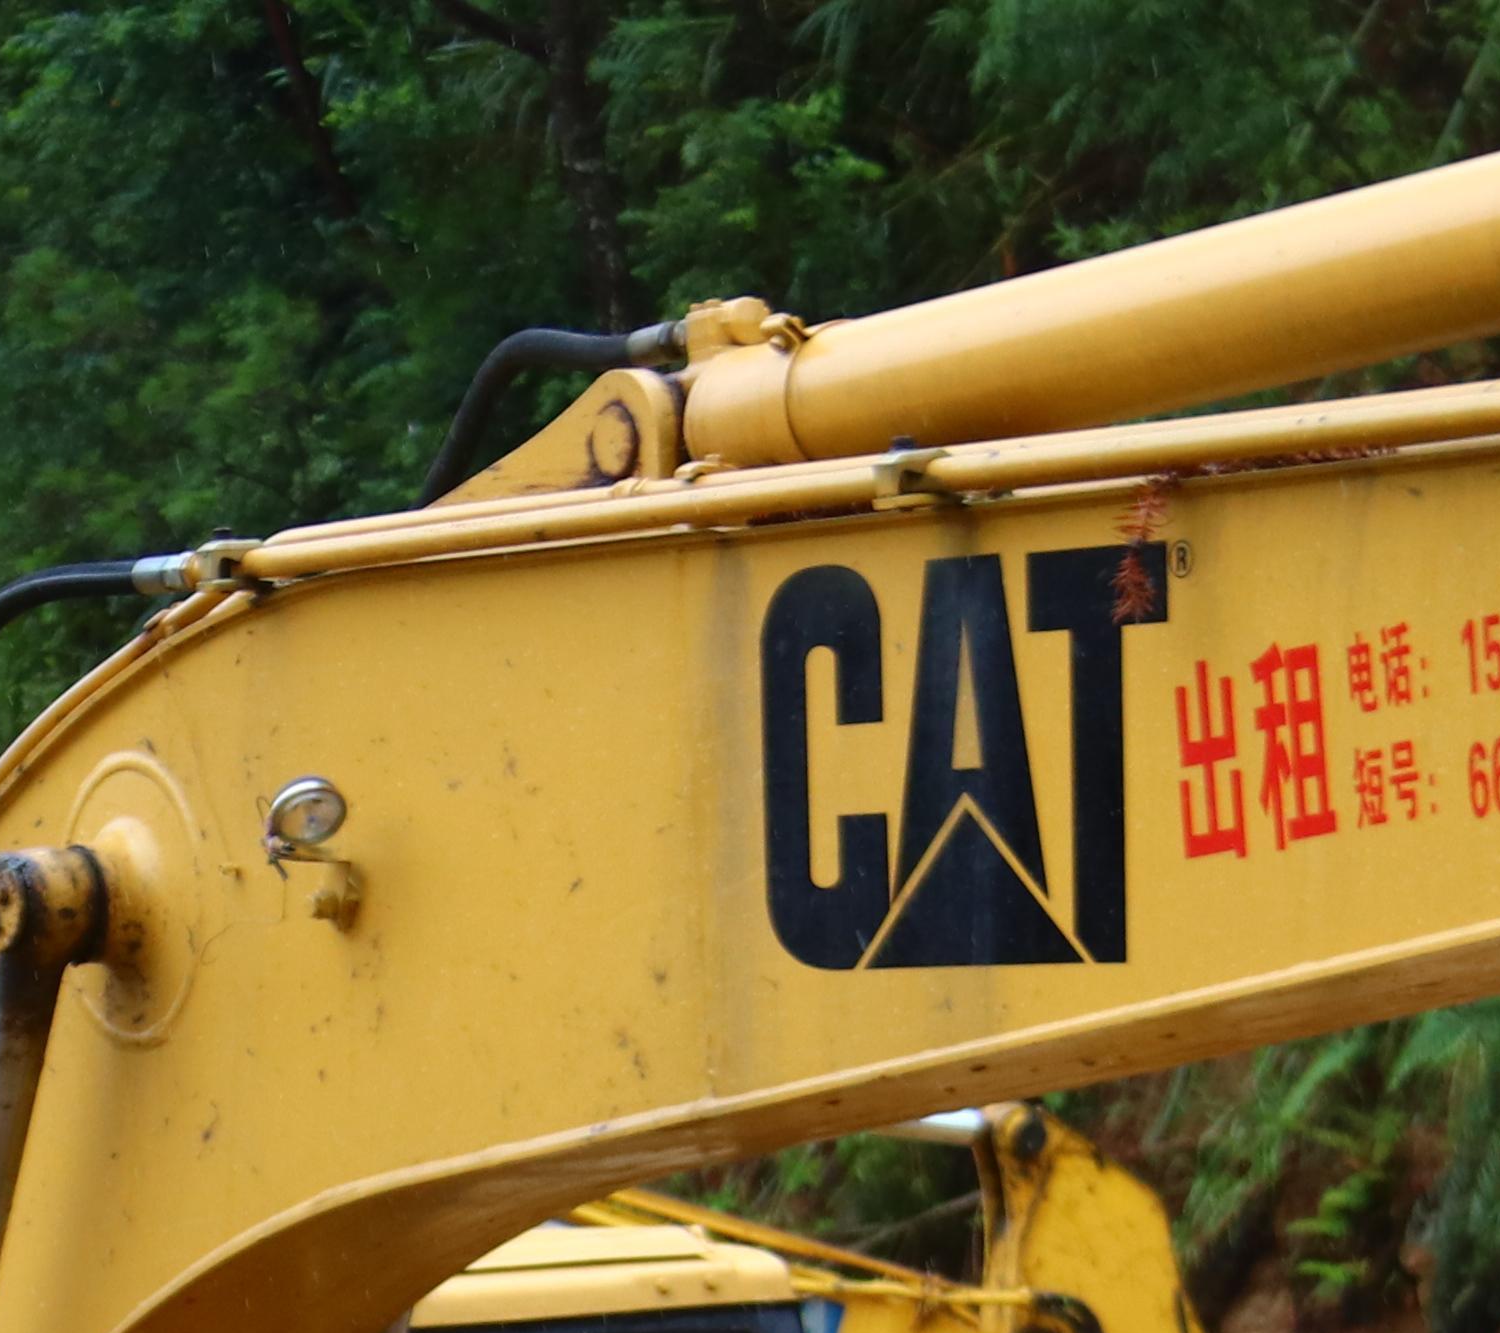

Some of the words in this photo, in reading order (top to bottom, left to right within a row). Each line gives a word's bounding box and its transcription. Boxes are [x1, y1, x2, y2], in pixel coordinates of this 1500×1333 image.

[1346, 621, 1430, 713] 电话：
[760, 541, 1168, 970] CAT
[1175, 643, 1338, 862] 出租
[1353, 740, 1437, 830] 短号：
